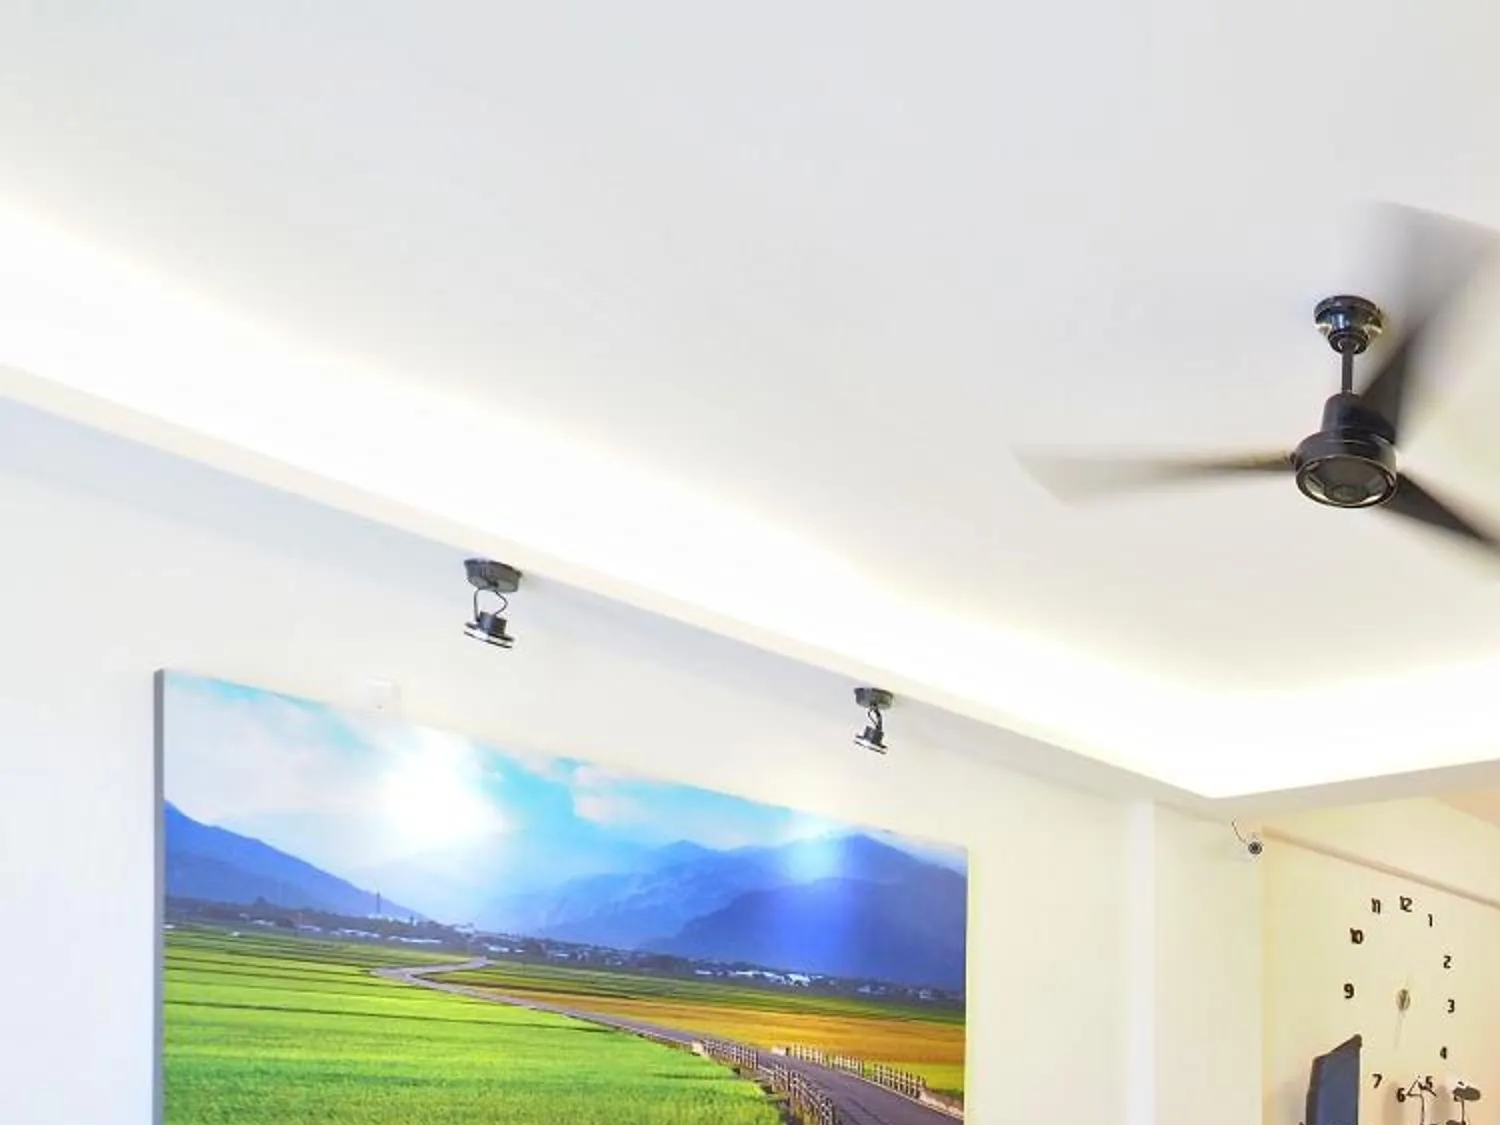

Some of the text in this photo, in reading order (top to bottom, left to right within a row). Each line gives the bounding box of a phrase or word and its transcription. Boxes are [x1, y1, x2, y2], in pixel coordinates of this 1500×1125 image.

[1371, 898, 1381, 914] 11
[1399, 895, 1413, 912] 12
[1428, 913, 1434, 927] 1
[1350, 928, 1364, 944] 10
[1443, 955, 1452, 969] 2
[1343, 983, 1355, 999] 9
[1447, 998, 1455, 1014] 3
[1440, 1046, 1448, 1060] 4
[1372, 1073, 1383, 1089] 7
[1424, 1076, 1433, 1090] 5
[1396, 1088, 1406, 1103] 6
